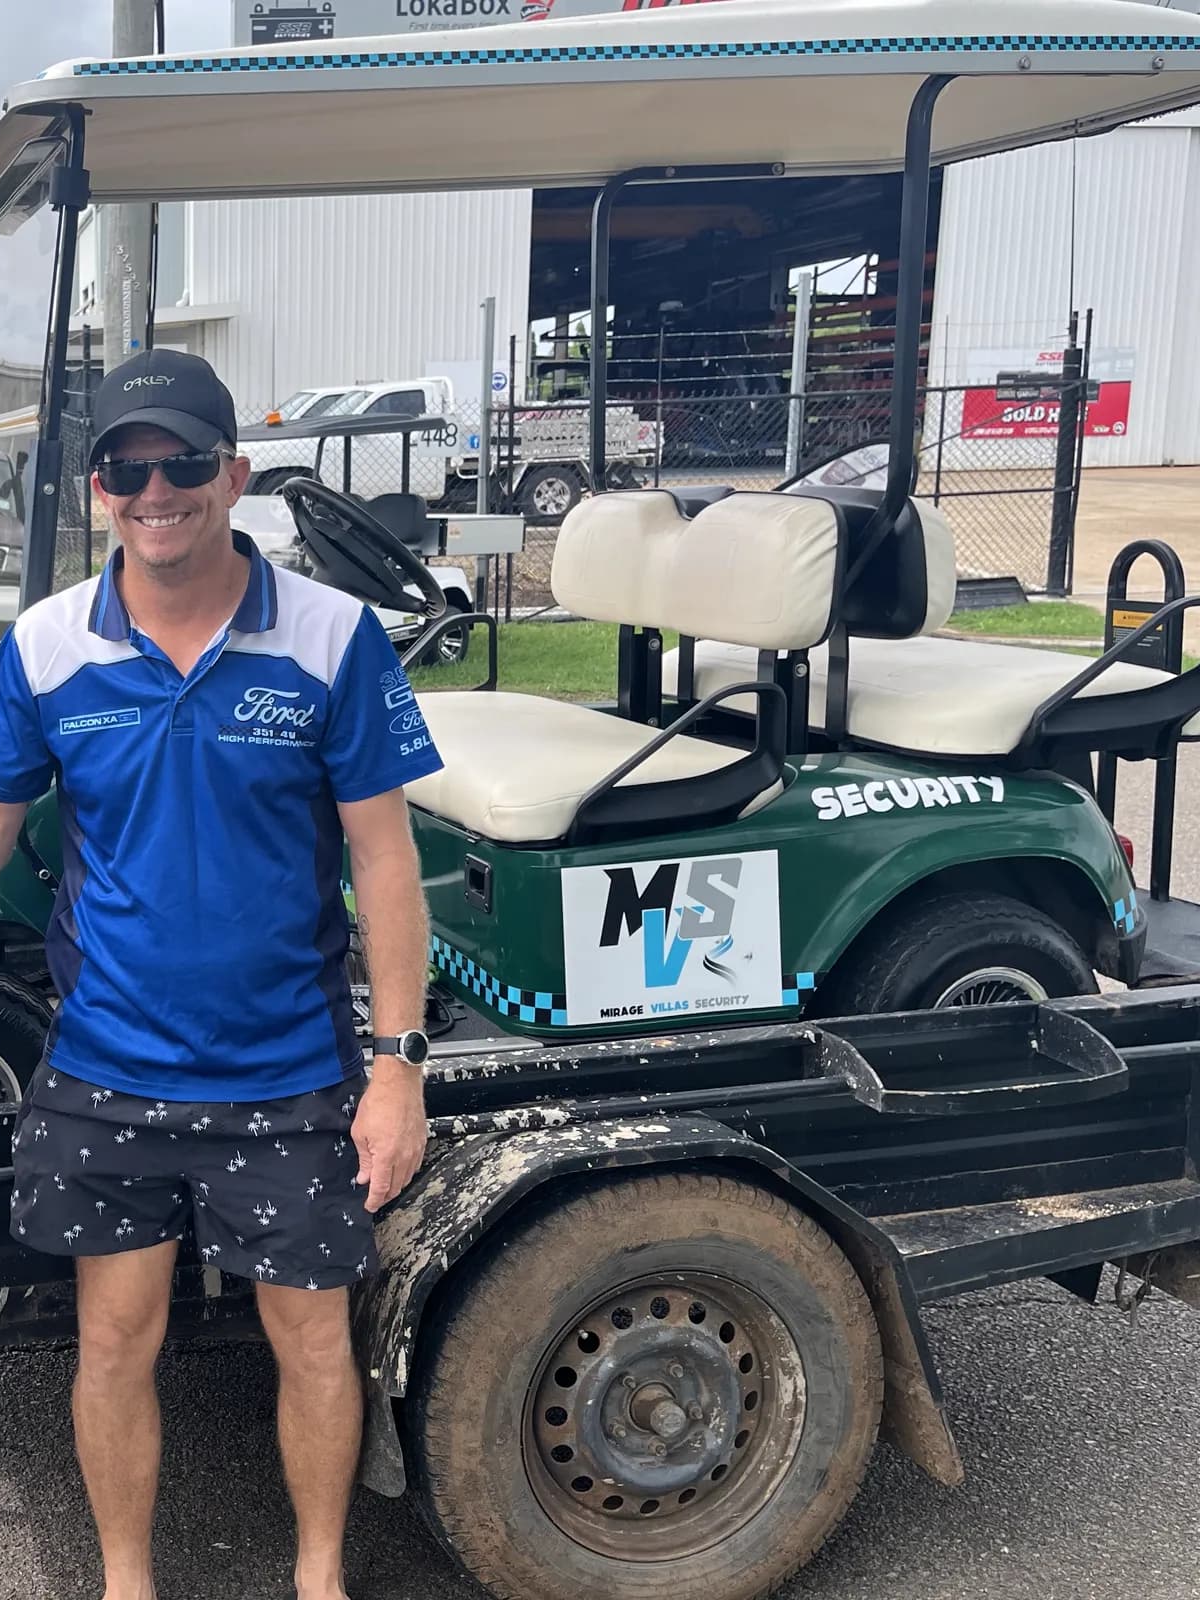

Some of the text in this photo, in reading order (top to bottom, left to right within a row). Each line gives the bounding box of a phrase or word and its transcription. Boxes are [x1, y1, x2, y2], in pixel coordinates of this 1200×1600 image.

[123, 375, 175, 391] OAKLEY
[234, 687, 315, 727] Ford
[63, 718, 102, 731] FALCON
[103, 715, 118, 724] XA
[217, 734, 245, 743] HIGH
[252, 727, 274, 737] 351
[811, 776, 1005, 820] SECURITY
[601, 995, 750, 1019] MIRAGE VILLAS SECURITY
